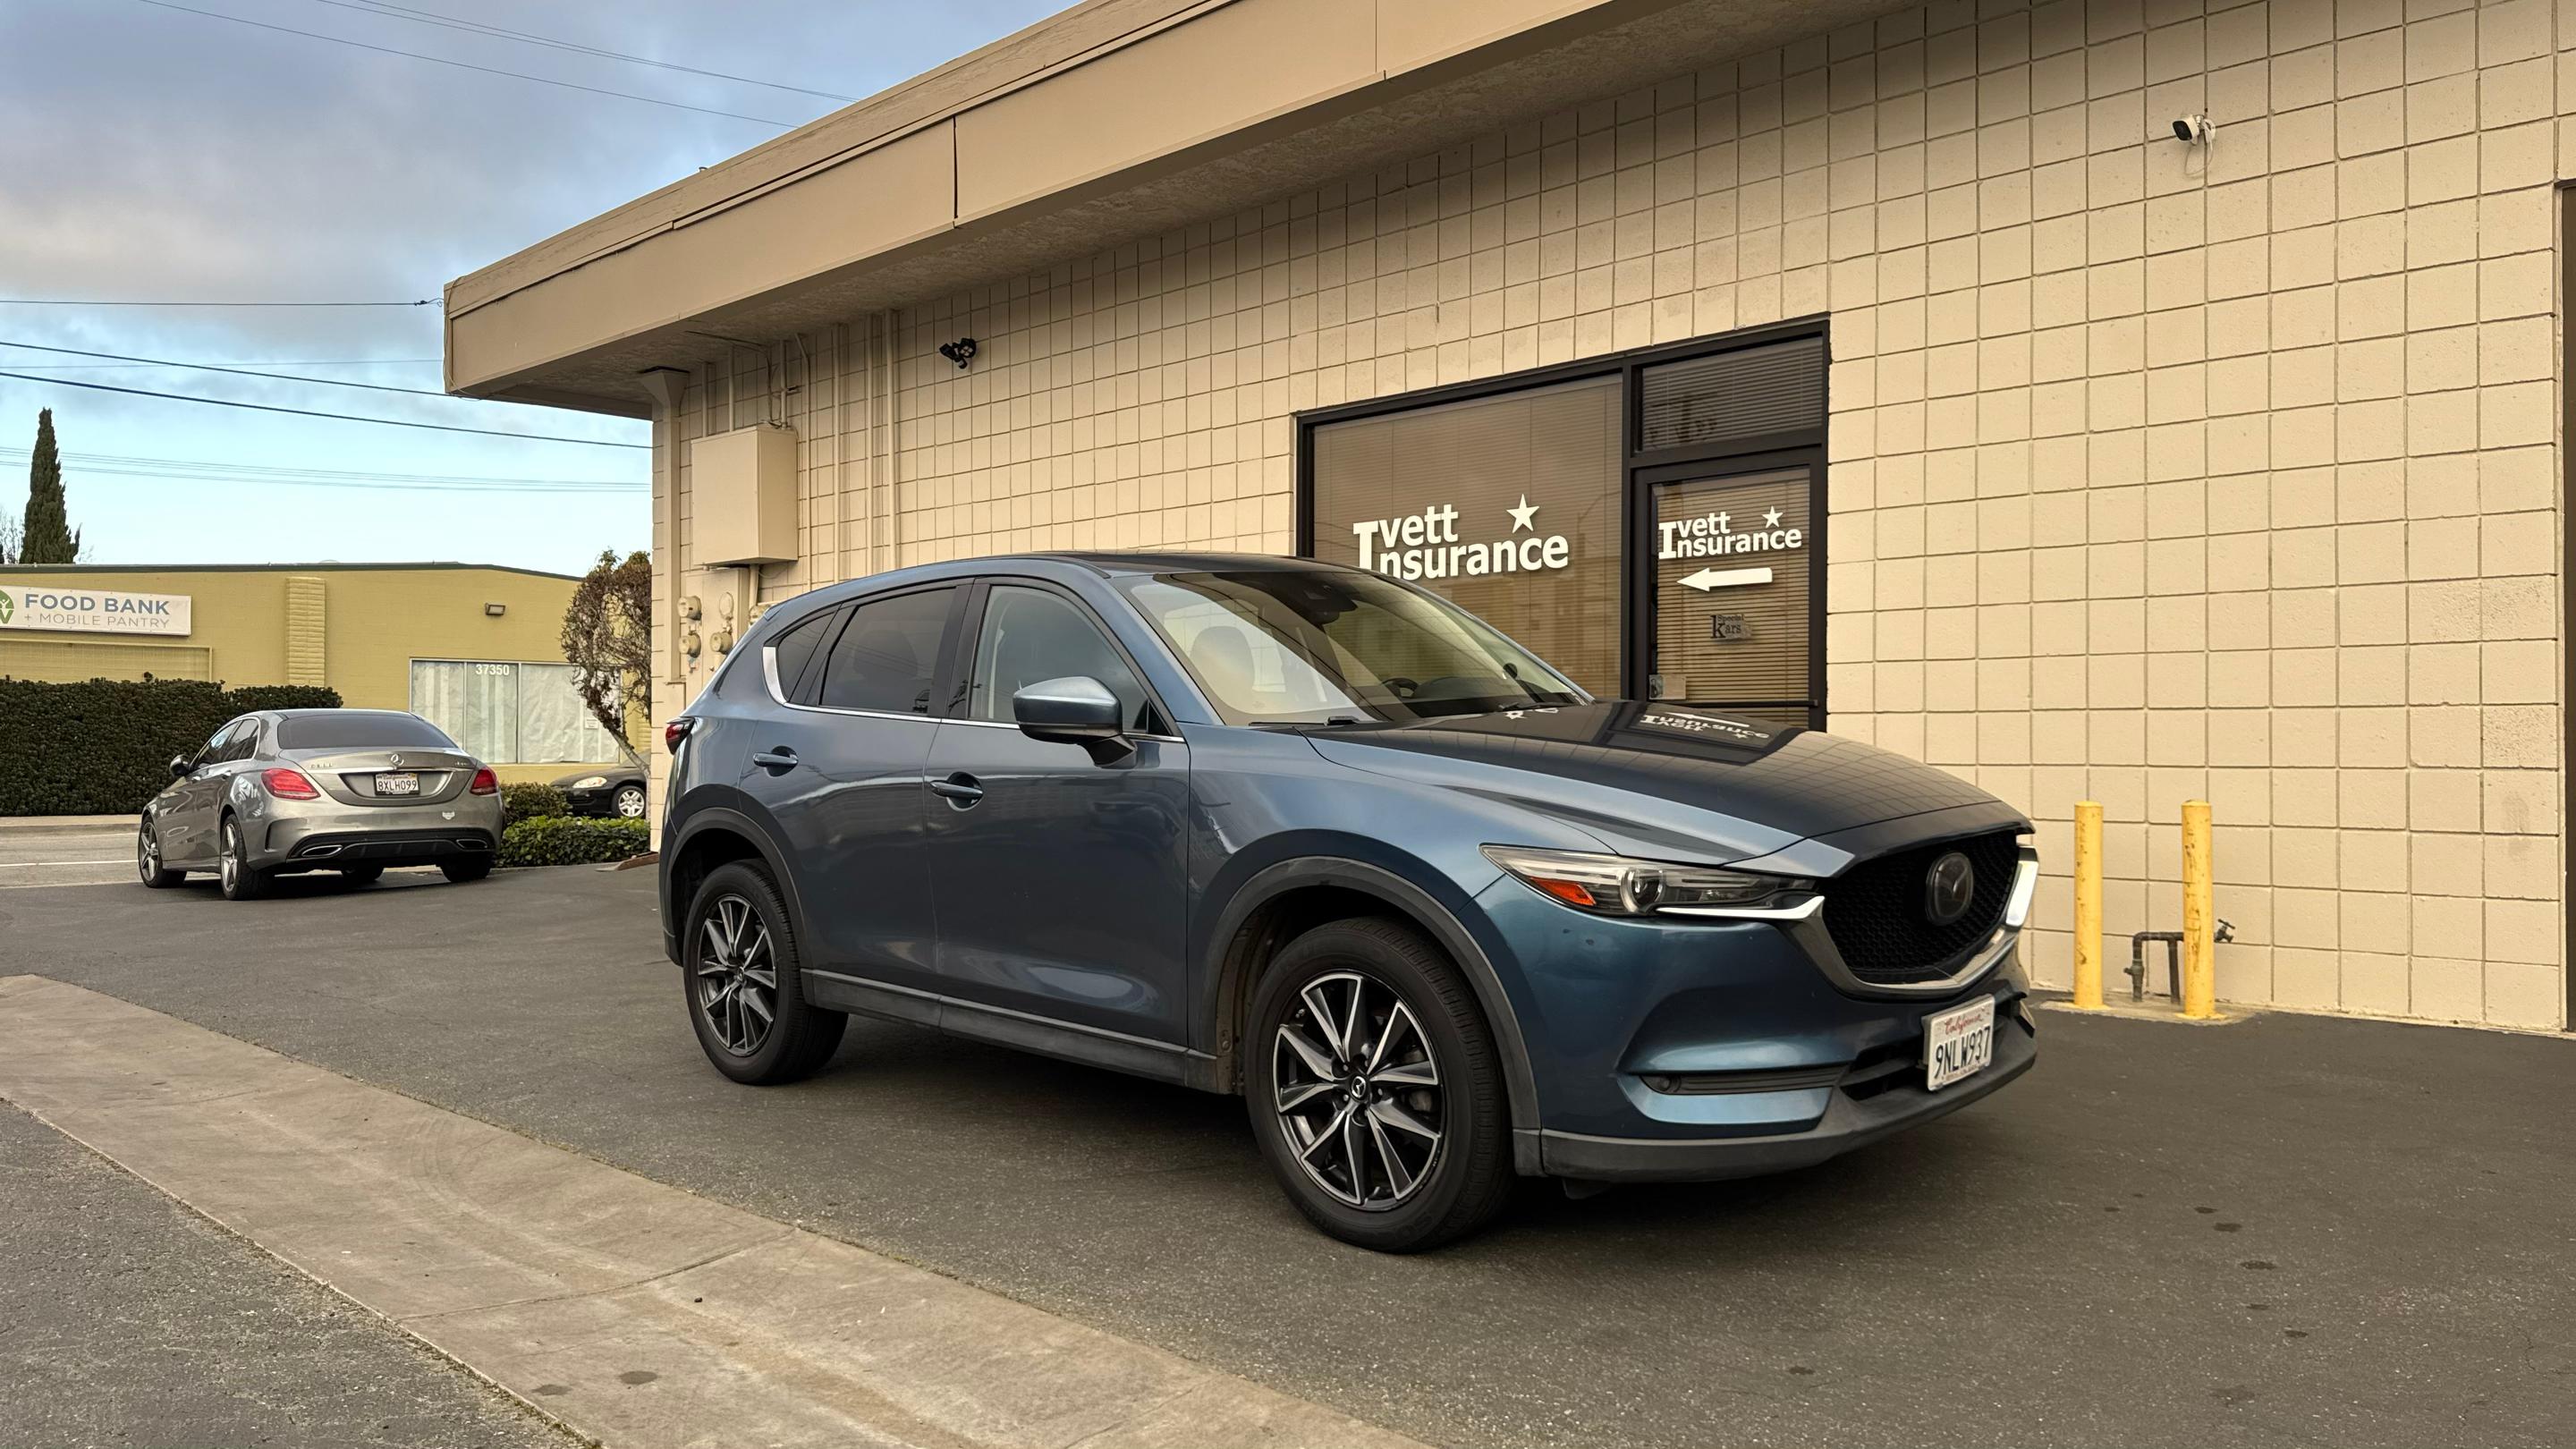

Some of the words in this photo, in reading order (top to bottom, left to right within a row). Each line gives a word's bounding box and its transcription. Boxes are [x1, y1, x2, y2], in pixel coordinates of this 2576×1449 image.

[1353, 504, 1459, 570] Ivett
[1658, 512, 1731, 559] Ivett
[25, 593, 96, 611] FOOD
[104, 597, 170, 615] BANK
[39, 613, 101, 626] MOBILE
[107, 616, 170, 628] PANTRY
[475, 664, 510, 676] 37350
[377, 780, 417, 791] 8XLH099
[1935, 1026, 1991, 1079] 9NLW937
